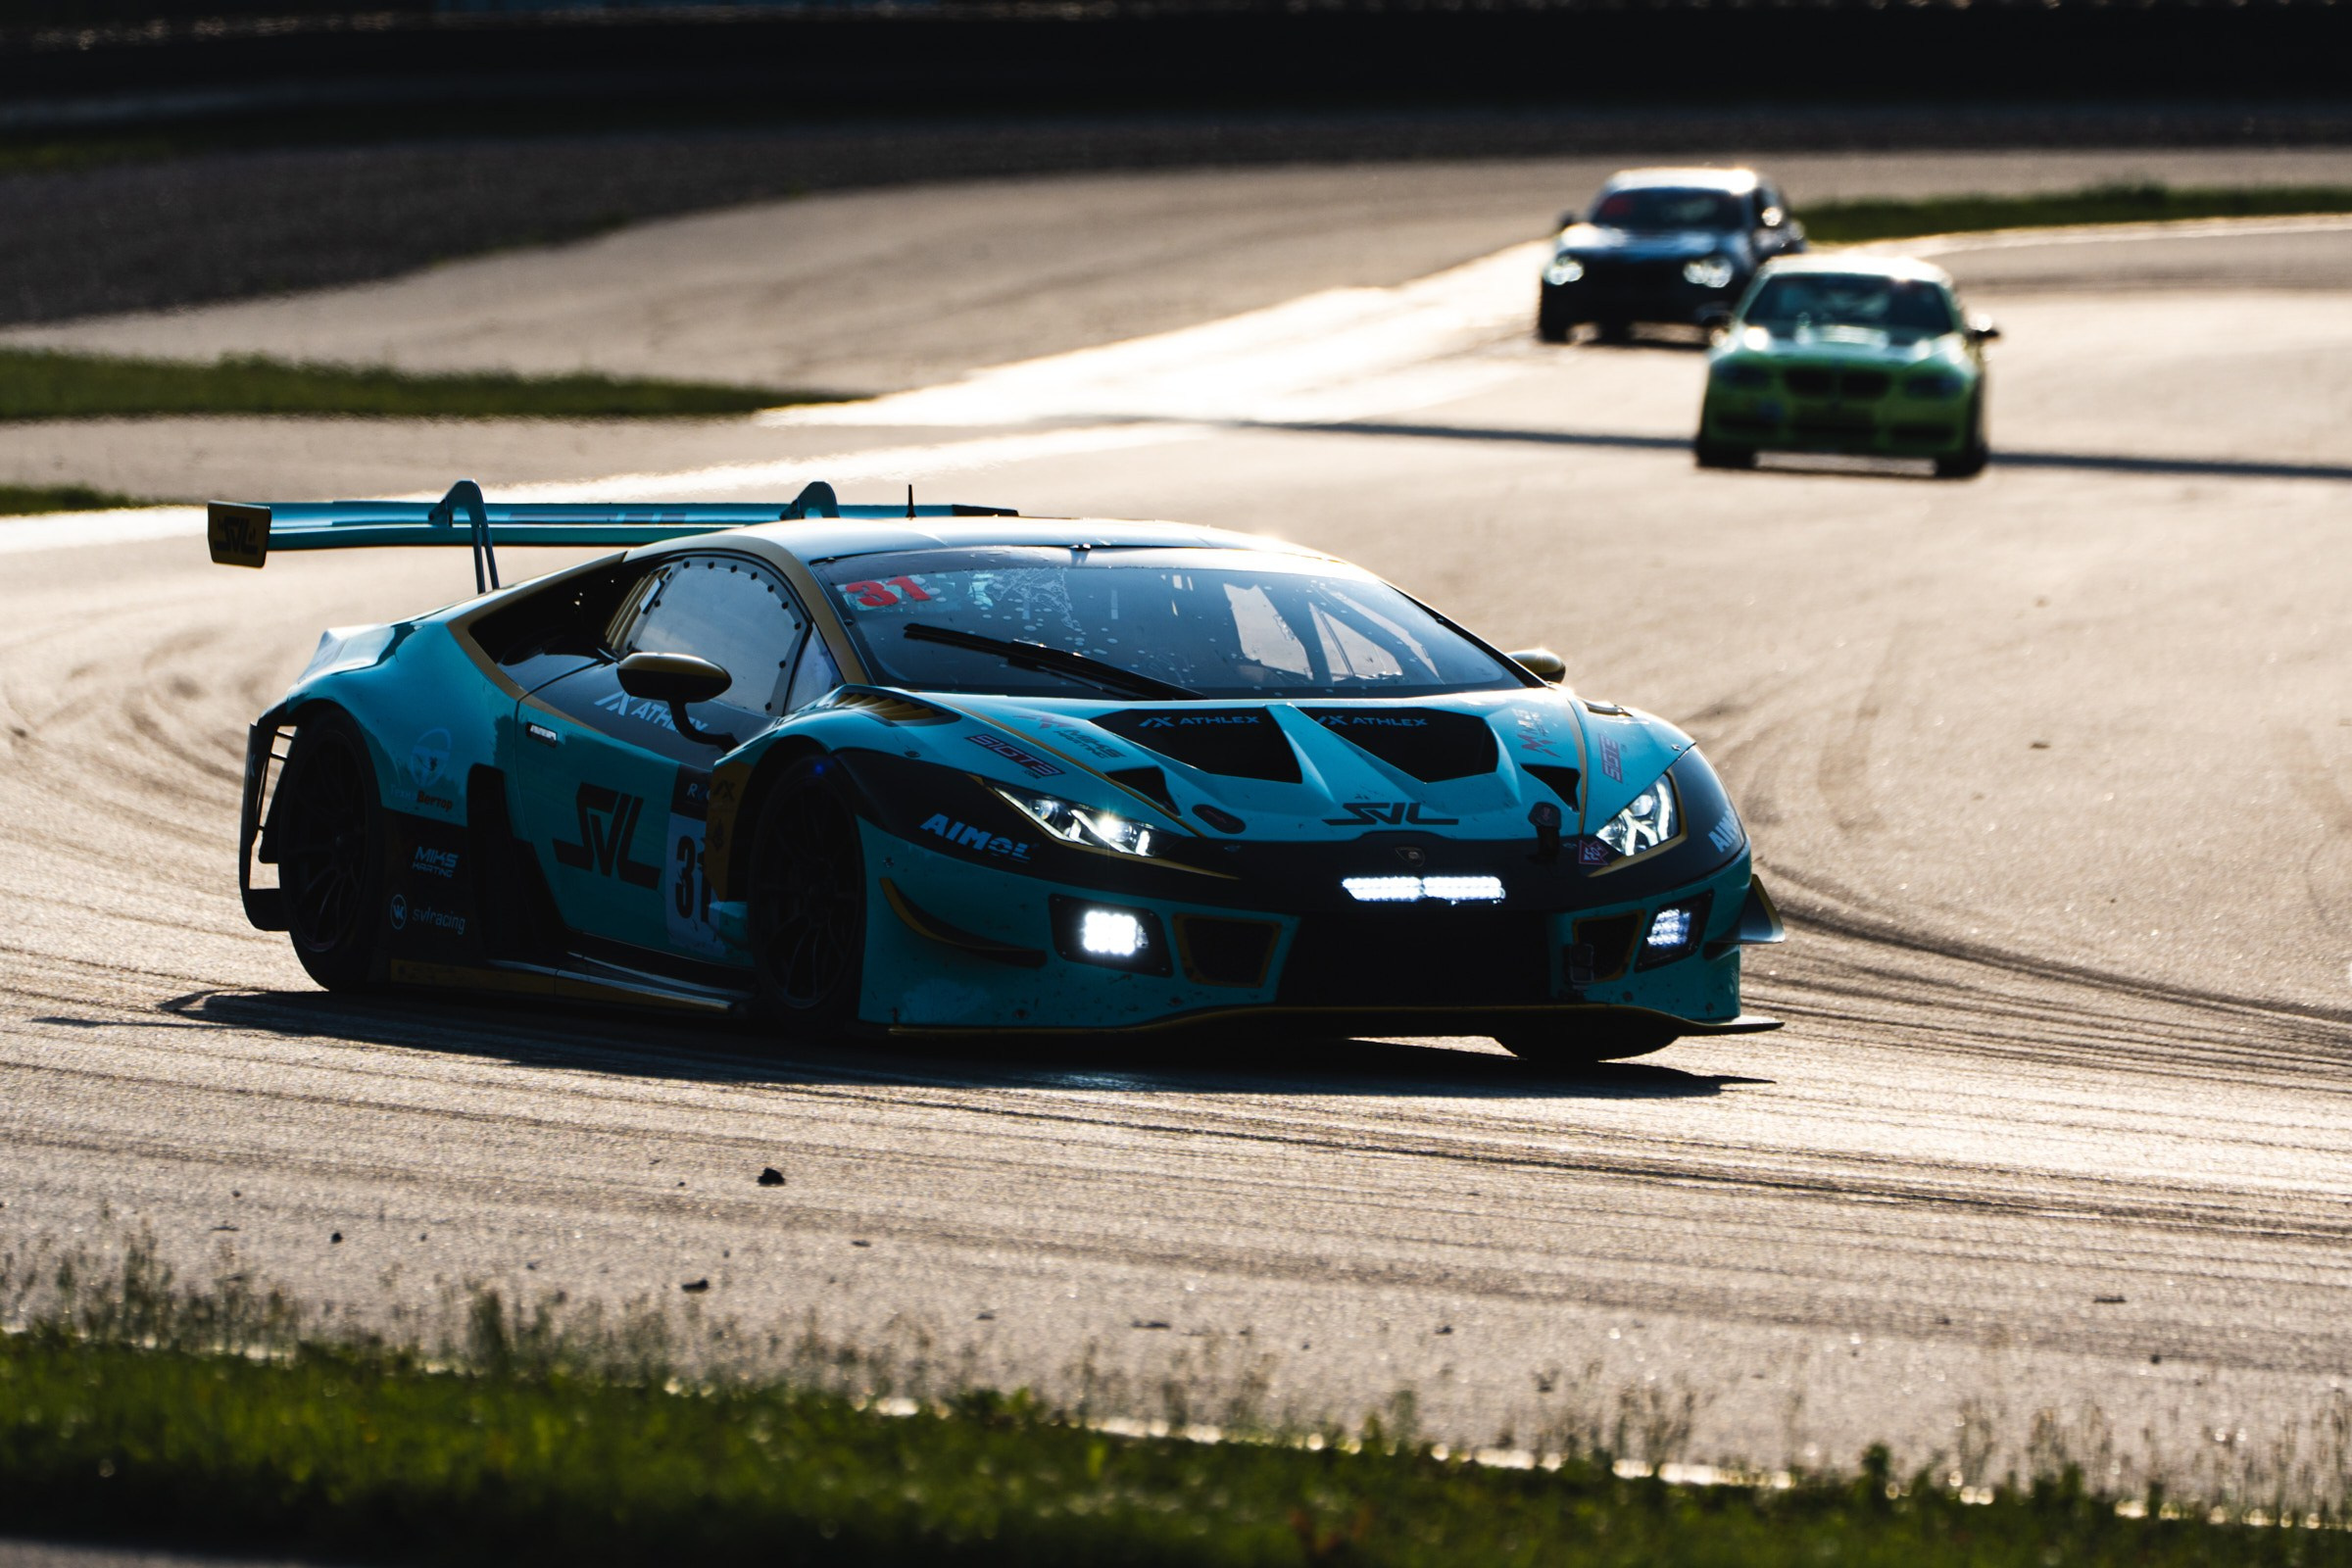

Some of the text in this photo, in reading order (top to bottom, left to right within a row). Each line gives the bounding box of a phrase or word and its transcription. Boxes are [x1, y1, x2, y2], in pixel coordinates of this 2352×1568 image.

[846, 575, 932, 607] 31
[1179, 716, 1261, 725] ATHLEX
[1352, 716, 1428, 727] ATHLEX
[1322, 803, 1459, 825] SVL
[553, 781, 662, 892] SVL
[920, 812, 1032, 862] AIMOL
[415, 846, 459, 868] MIKS
[413, 906, 466, 935] svlracing
